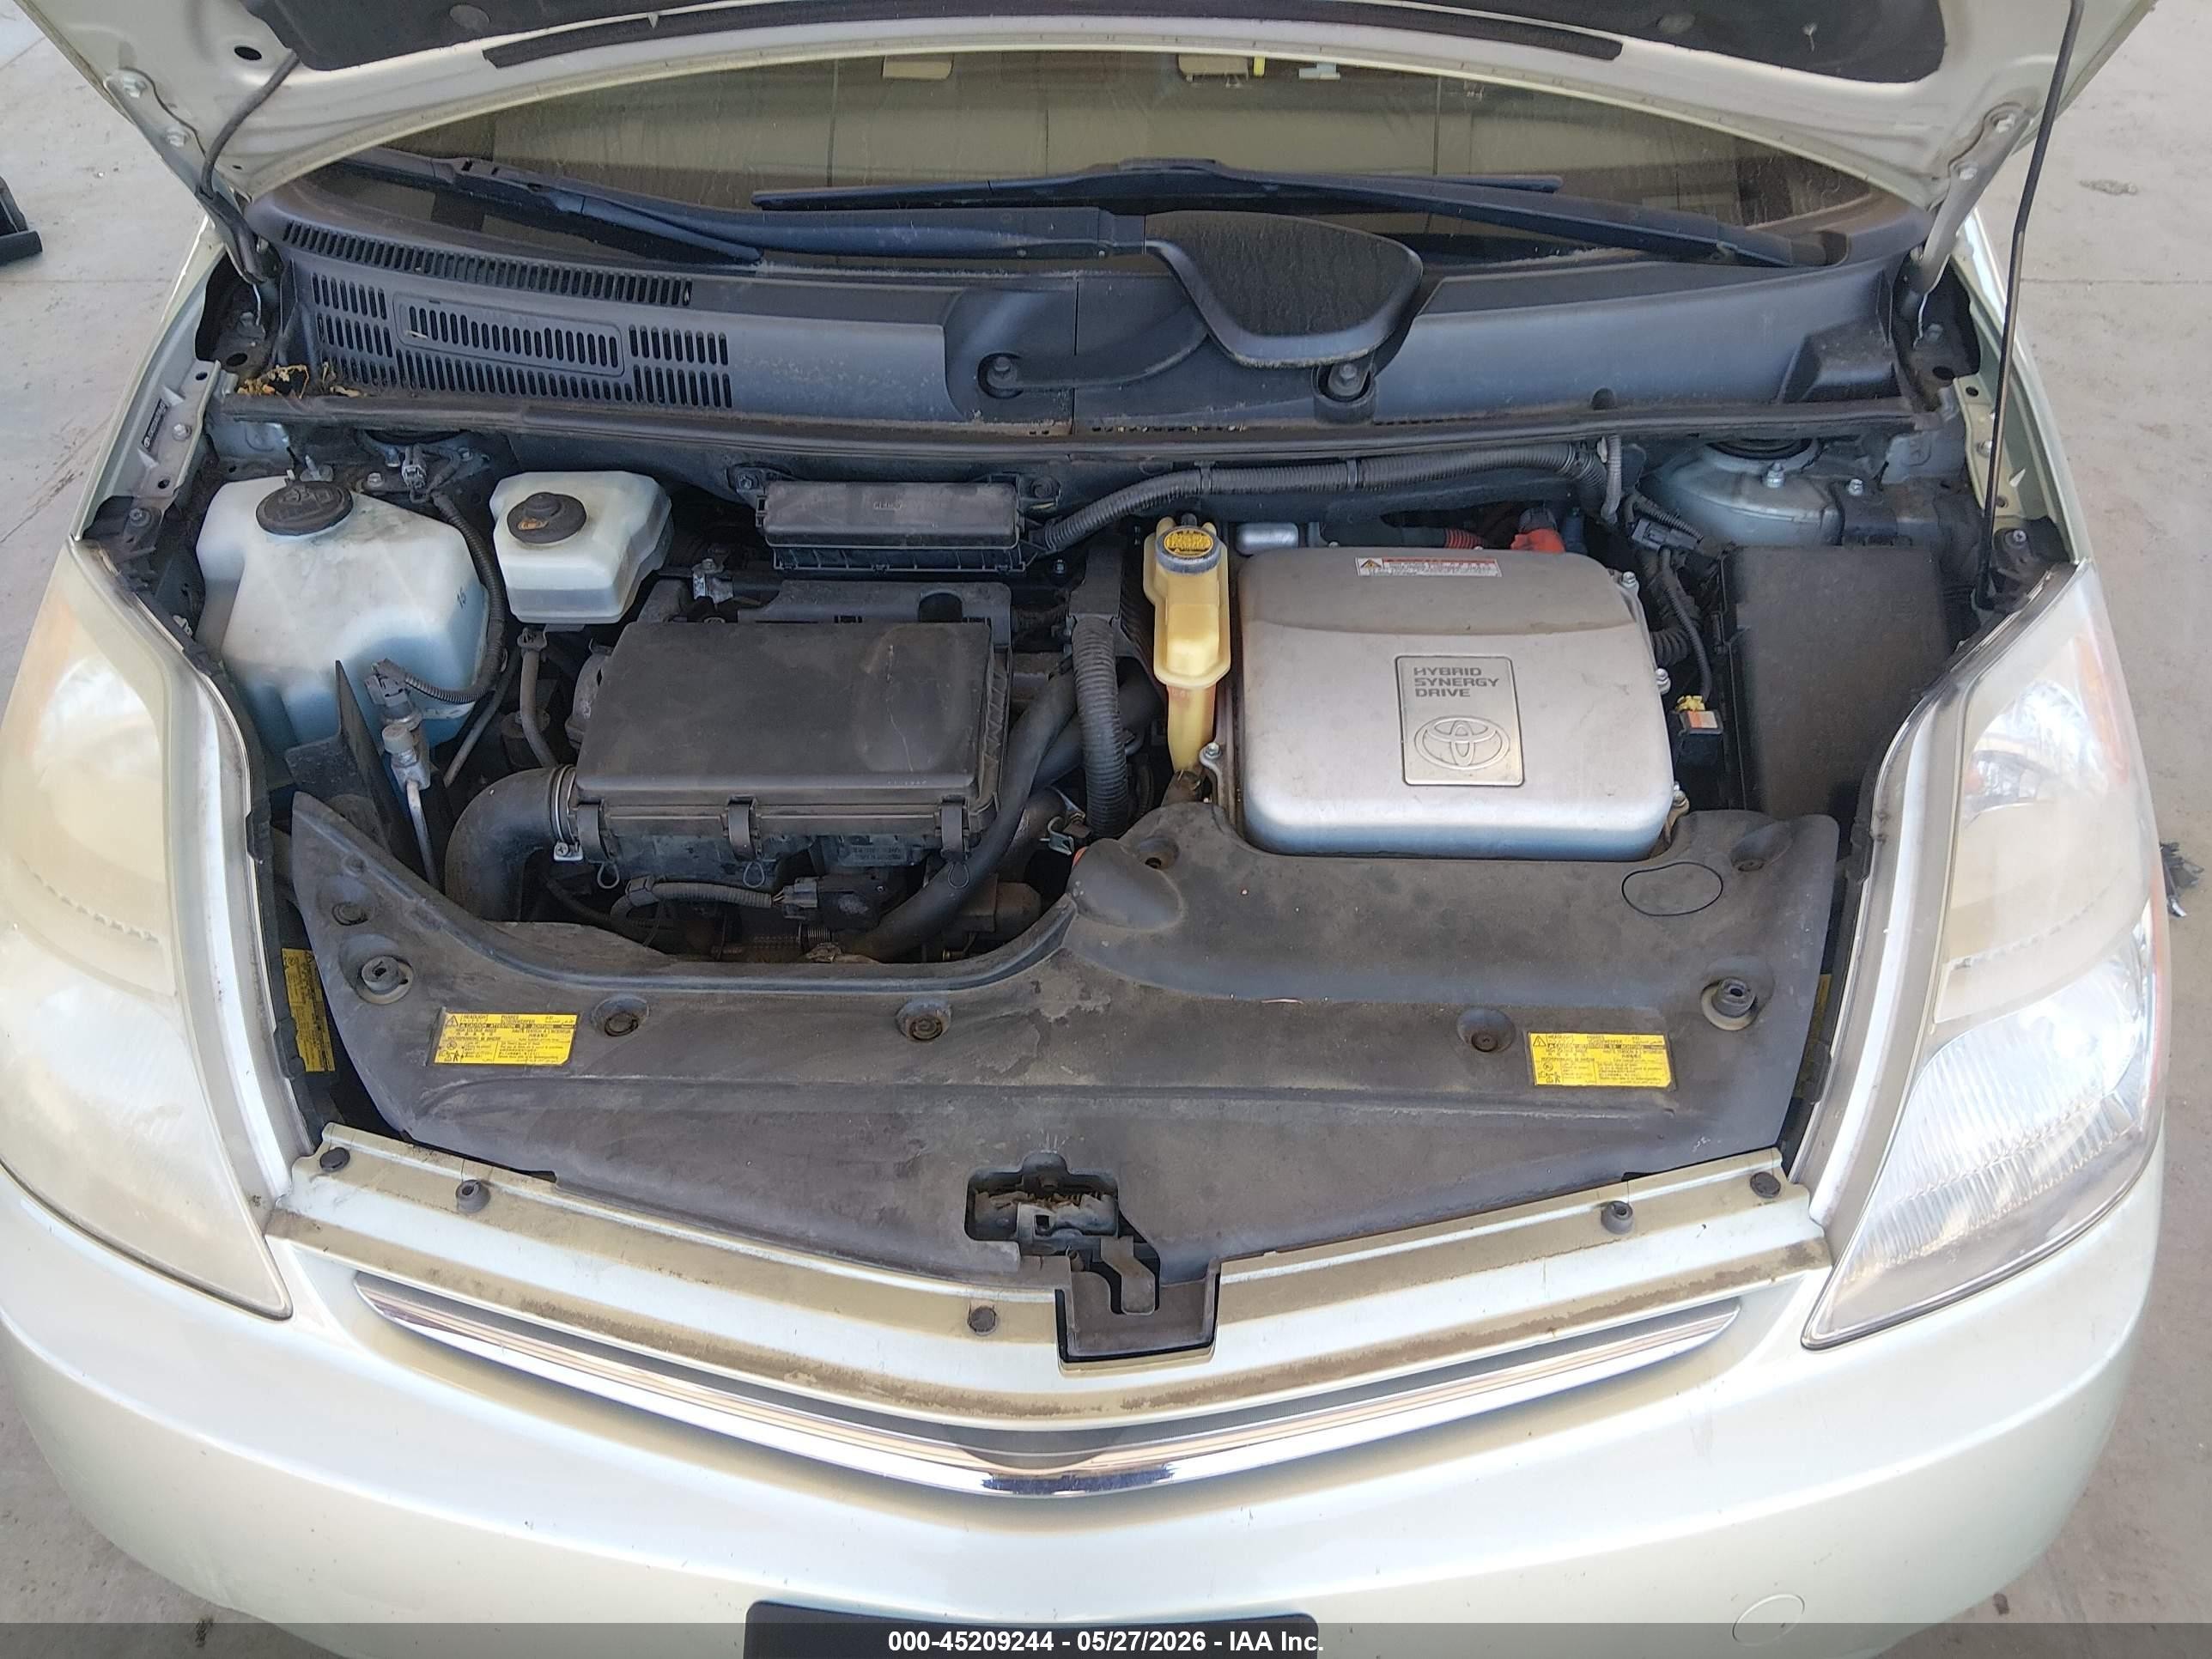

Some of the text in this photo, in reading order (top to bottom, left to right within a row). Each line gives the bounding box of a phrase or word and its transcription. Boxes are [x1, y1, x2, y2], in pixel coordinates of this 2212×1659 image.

[1413, 667, 1482, 676] HYBRID
[1414, 678, 1499, 687] SYNERGY
[1415, 689, 1471, 697] DRIVE
